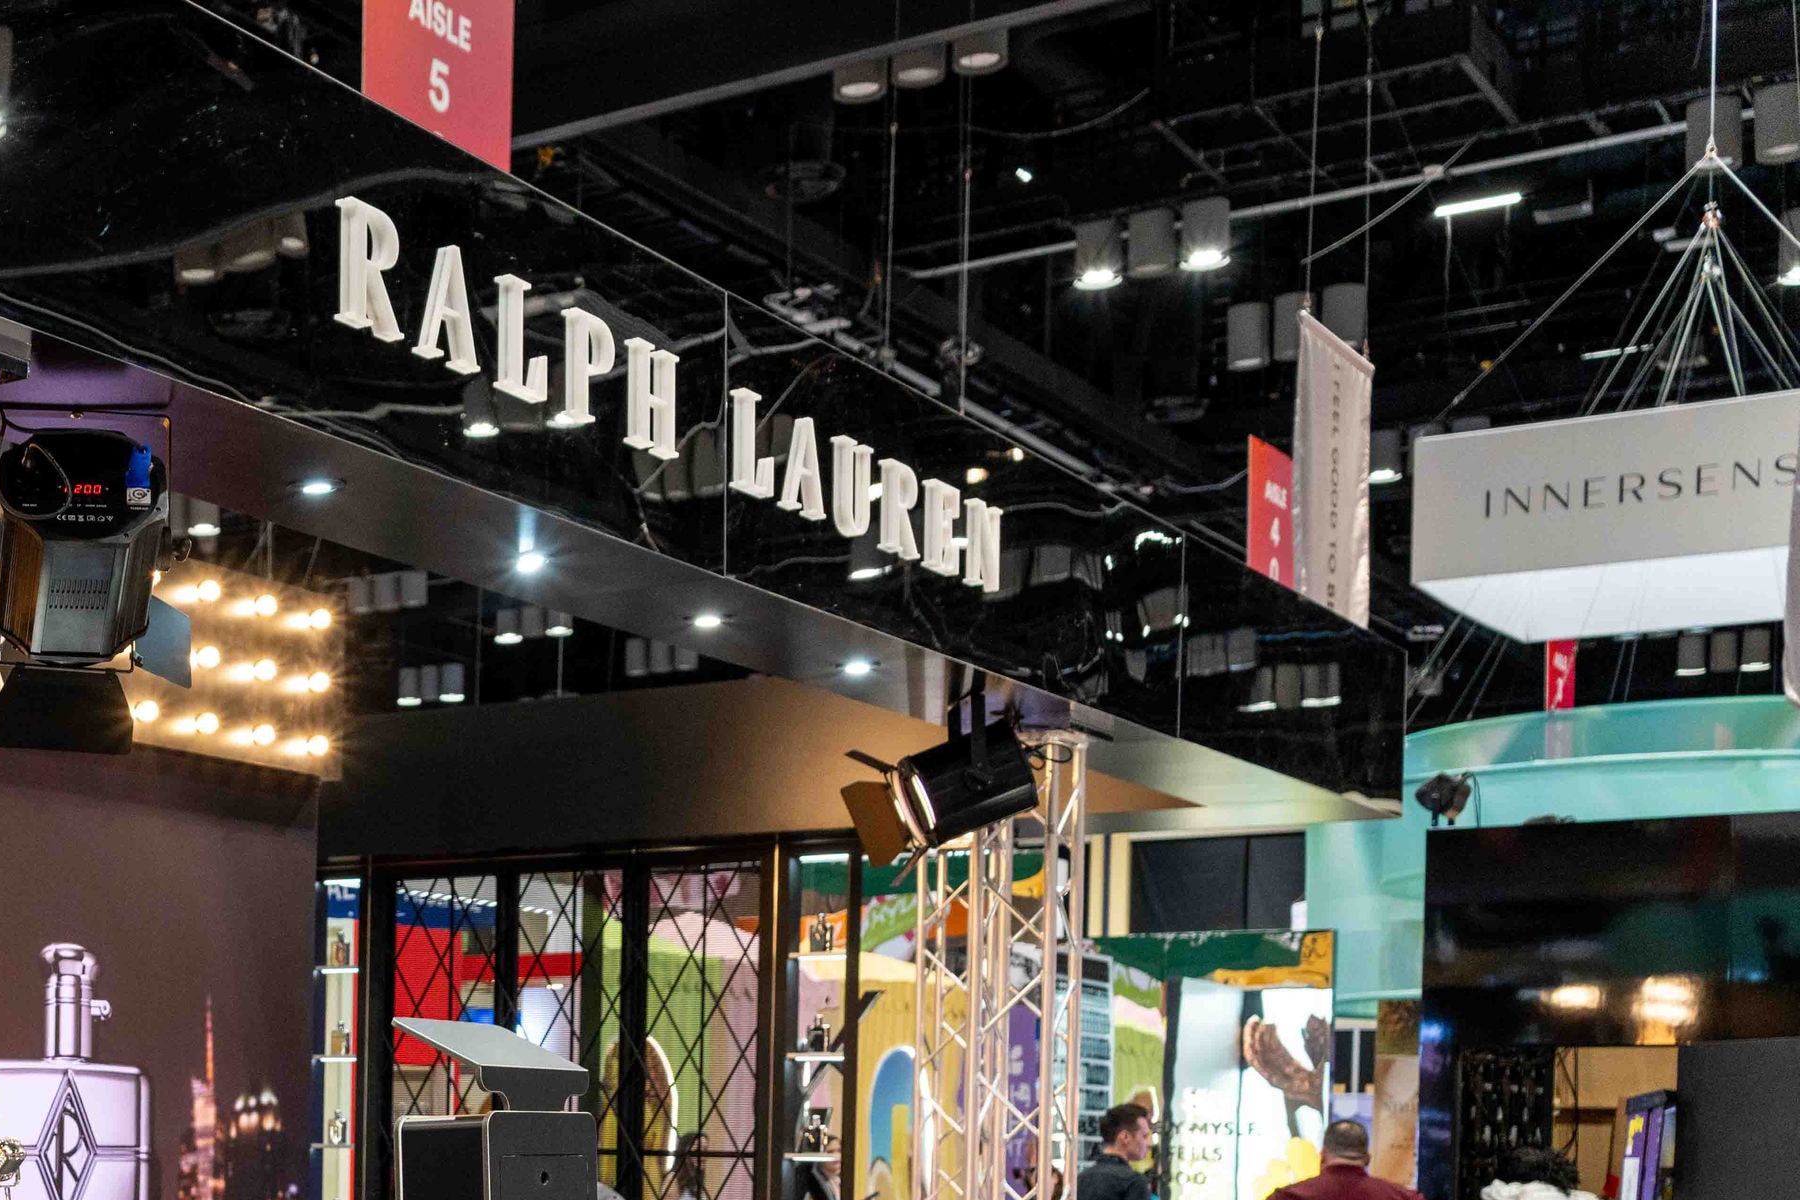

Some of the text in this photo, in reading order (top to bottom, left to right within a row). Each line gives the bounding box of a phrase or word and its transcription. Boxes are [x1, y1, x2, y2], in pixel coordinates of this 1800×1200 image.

[408, 0, 472, 54] AISLE
[427, 57, 451, 114] 5
[334, 195, 1004, 594] RALPH LAUREN
